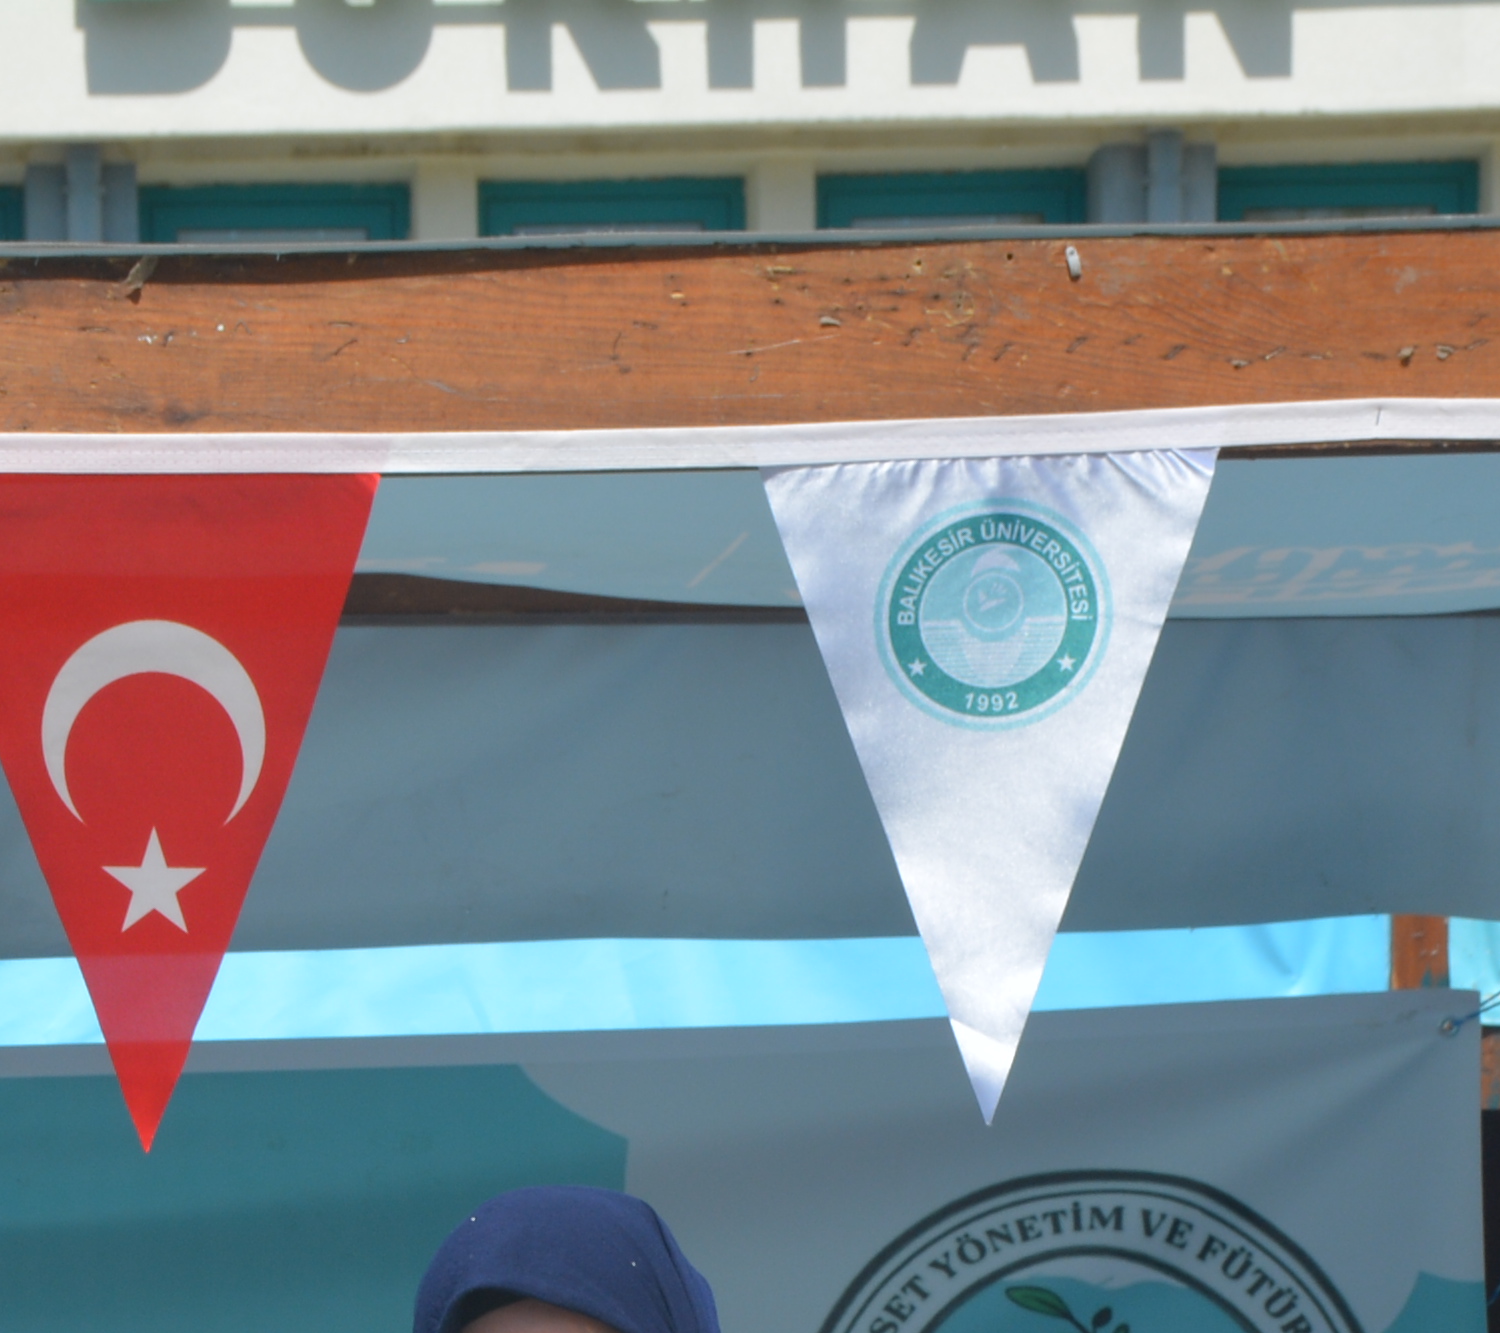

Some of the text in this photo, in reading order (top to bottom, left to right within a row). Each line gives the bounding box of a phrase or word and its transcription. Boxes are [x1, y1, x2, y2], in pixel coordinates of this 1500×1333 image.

[897, 518, 1093, 625] BALIKESİR ÜNİVERSİTESİ
[965, 691, 1019, 712] 1992
[928, 1200, 1125, 1280] YÖNETİM
[1140, 1207, 1195, 1250] VE
